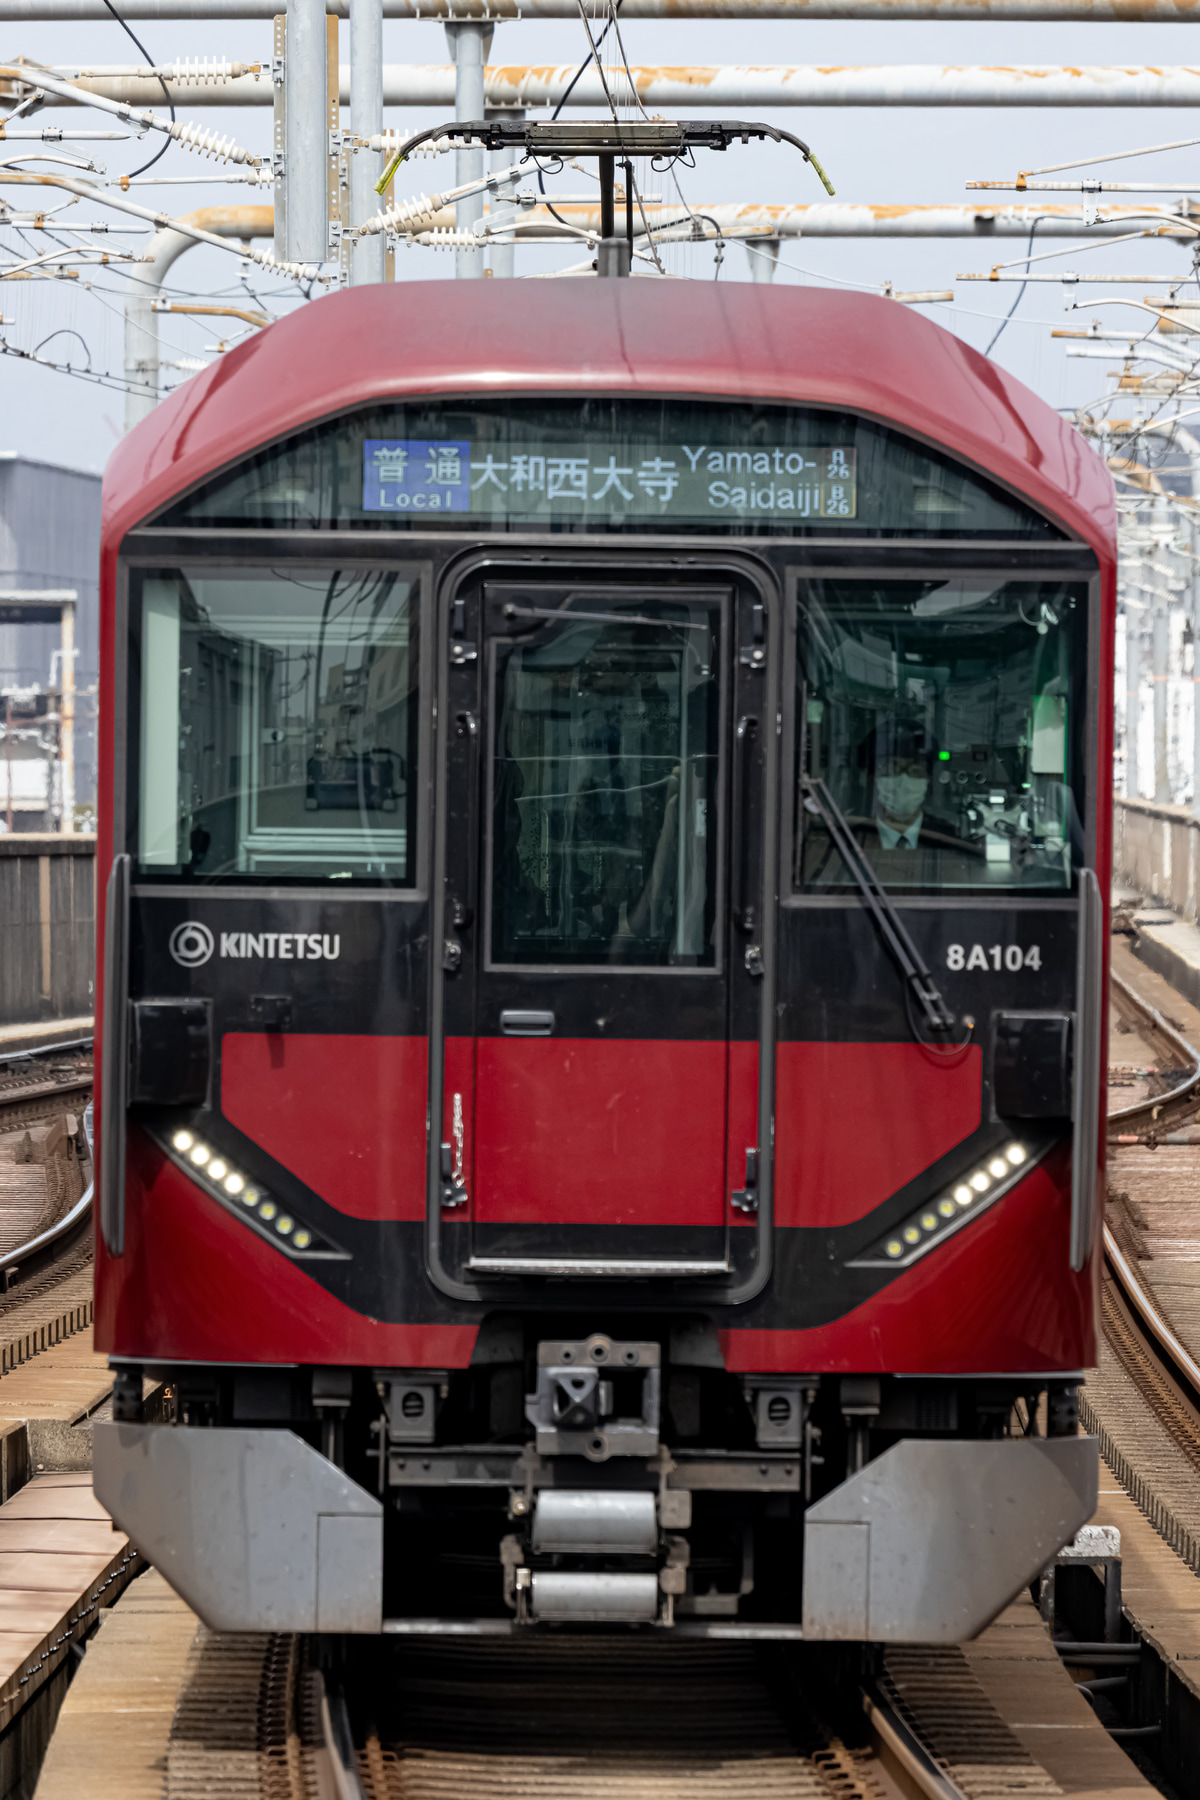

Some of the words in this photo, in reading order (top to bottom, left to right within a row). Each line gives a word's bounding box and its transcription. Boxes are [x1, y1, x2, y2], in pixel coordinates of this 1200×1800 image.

[372, 446, 462, 485] 普通
[681, 445, 817, 475] Yamato-
[826, 464, 850, 480] 26
[470, 454, 680, 501] 大和西大寺
[380, 488, 452, 508] Local
[708, 480, 820, 517] Saidaiji
[830, 484, 845, 501] B
[826, 500, 850, 515] 26
[220, 931, 341, 960] KINTETSU
[946, 943, 1043, 972] 8A104
